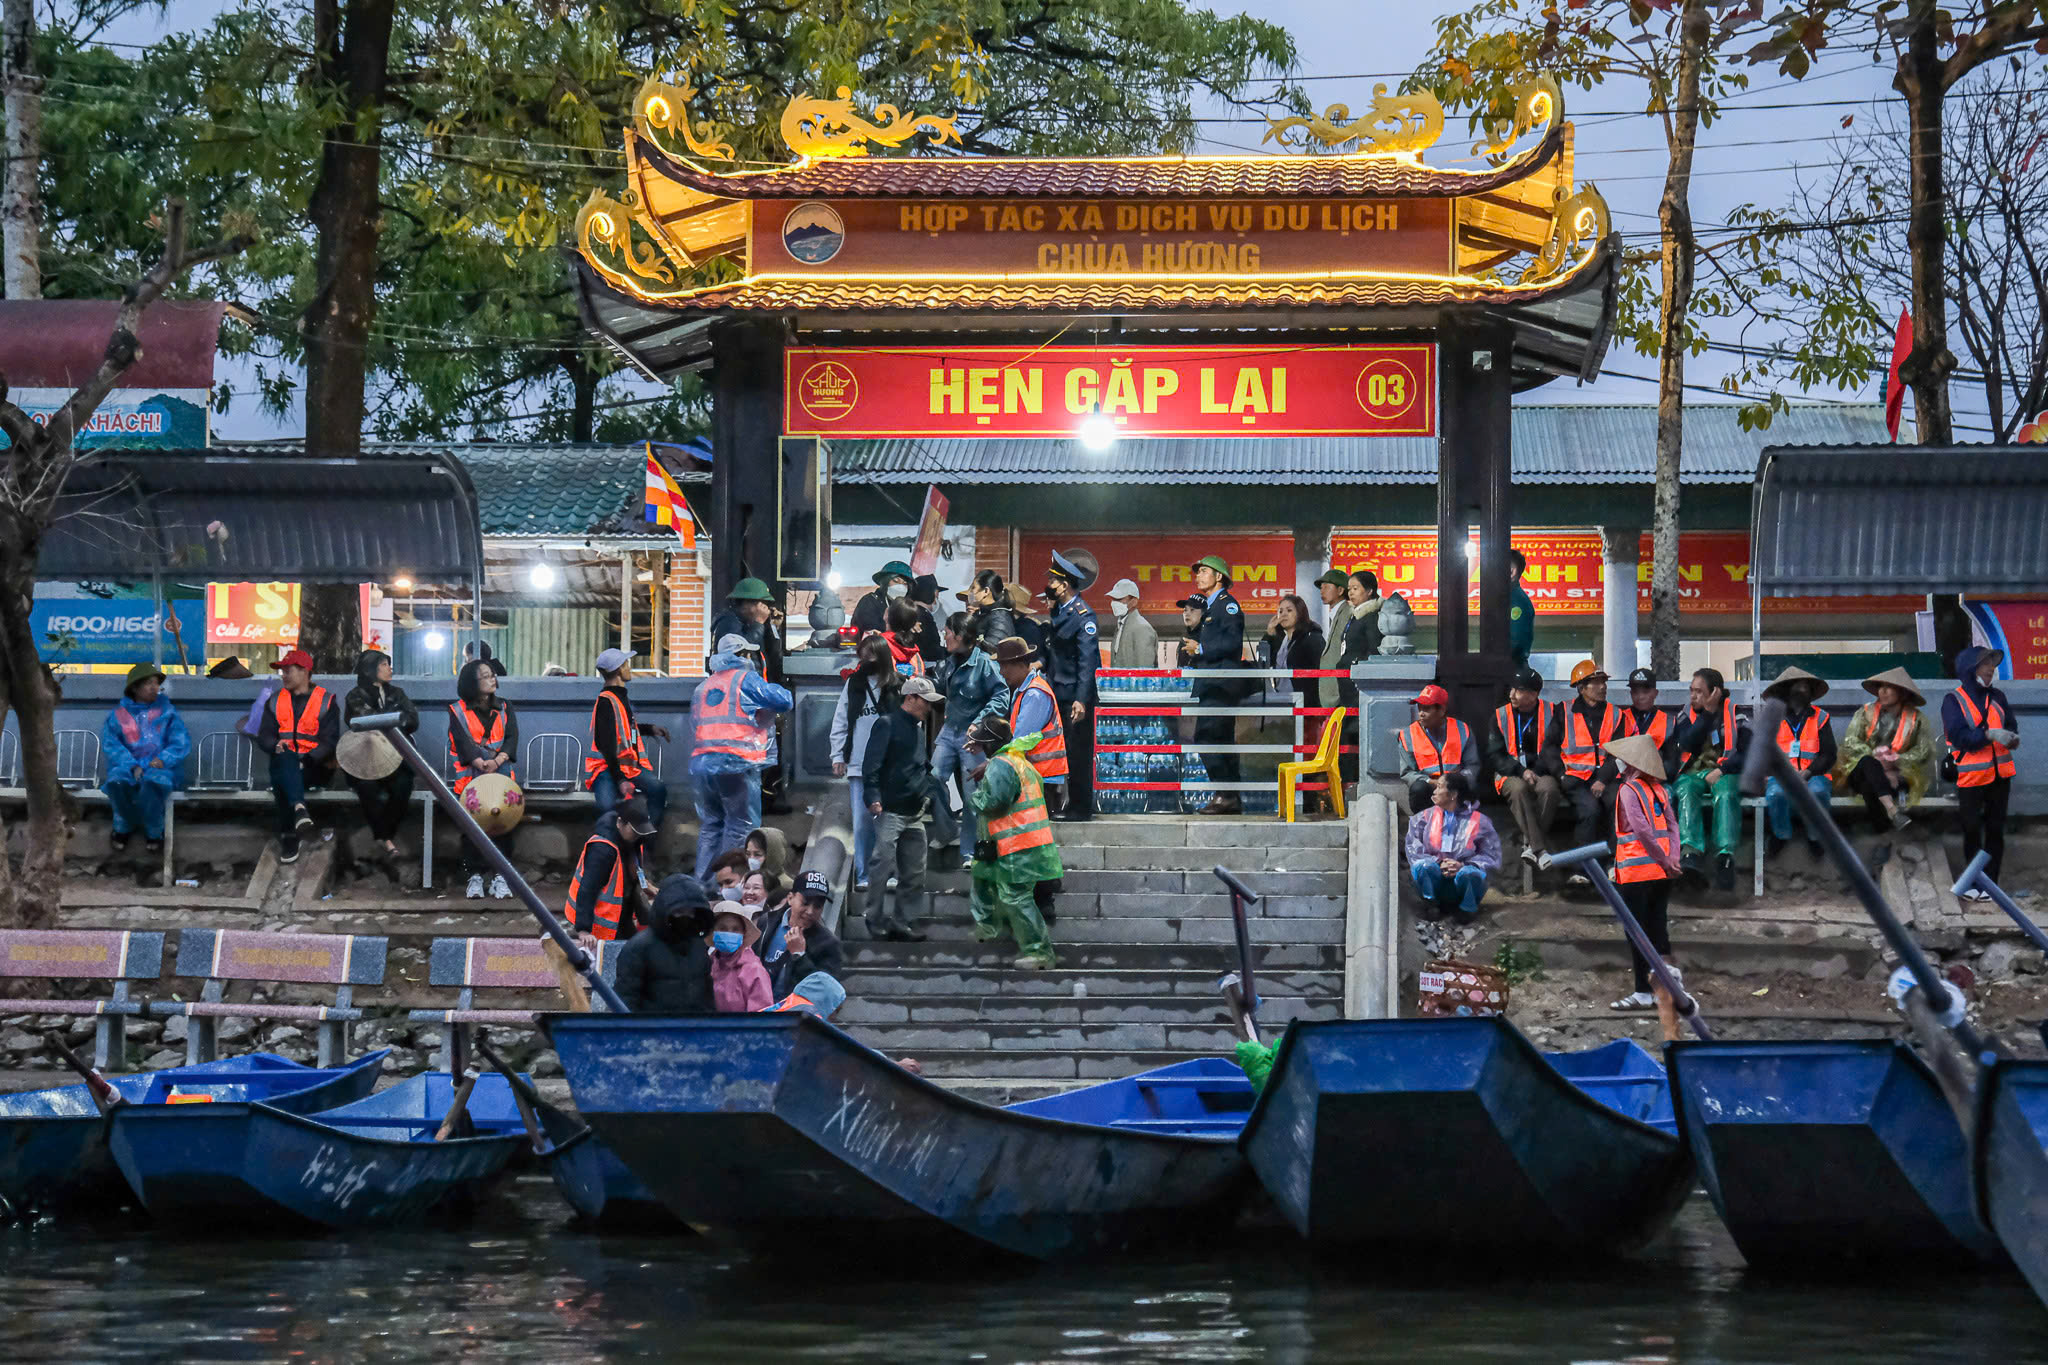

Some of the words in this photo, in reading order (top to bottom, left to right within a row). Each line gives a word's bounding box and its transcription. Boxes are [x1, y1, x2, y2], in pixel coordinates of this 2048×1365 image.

[900, 203, 969, 238] HỢP
[980, 199, 1045, 232] TÁC
[1116, 205, 1197, 237] DỊCH
[1209, 205, 1253, 238] VỤ
[1263, 204, 1311, 232] DU
[1321, 204, 1399, 236] LỊCH
[1037, 234, 1130, 273] CHÙA
[1141, 239, 1261, 273] HƯƠNG
[929, 368, 1043, 425] HẸN
[1064, 357, 1180, 425] GẶP
[1199, 367, 1288, 425] LẠI
[1367, 373, 1406, 407] 03
[1131, 565, 1277, 582] TRM
